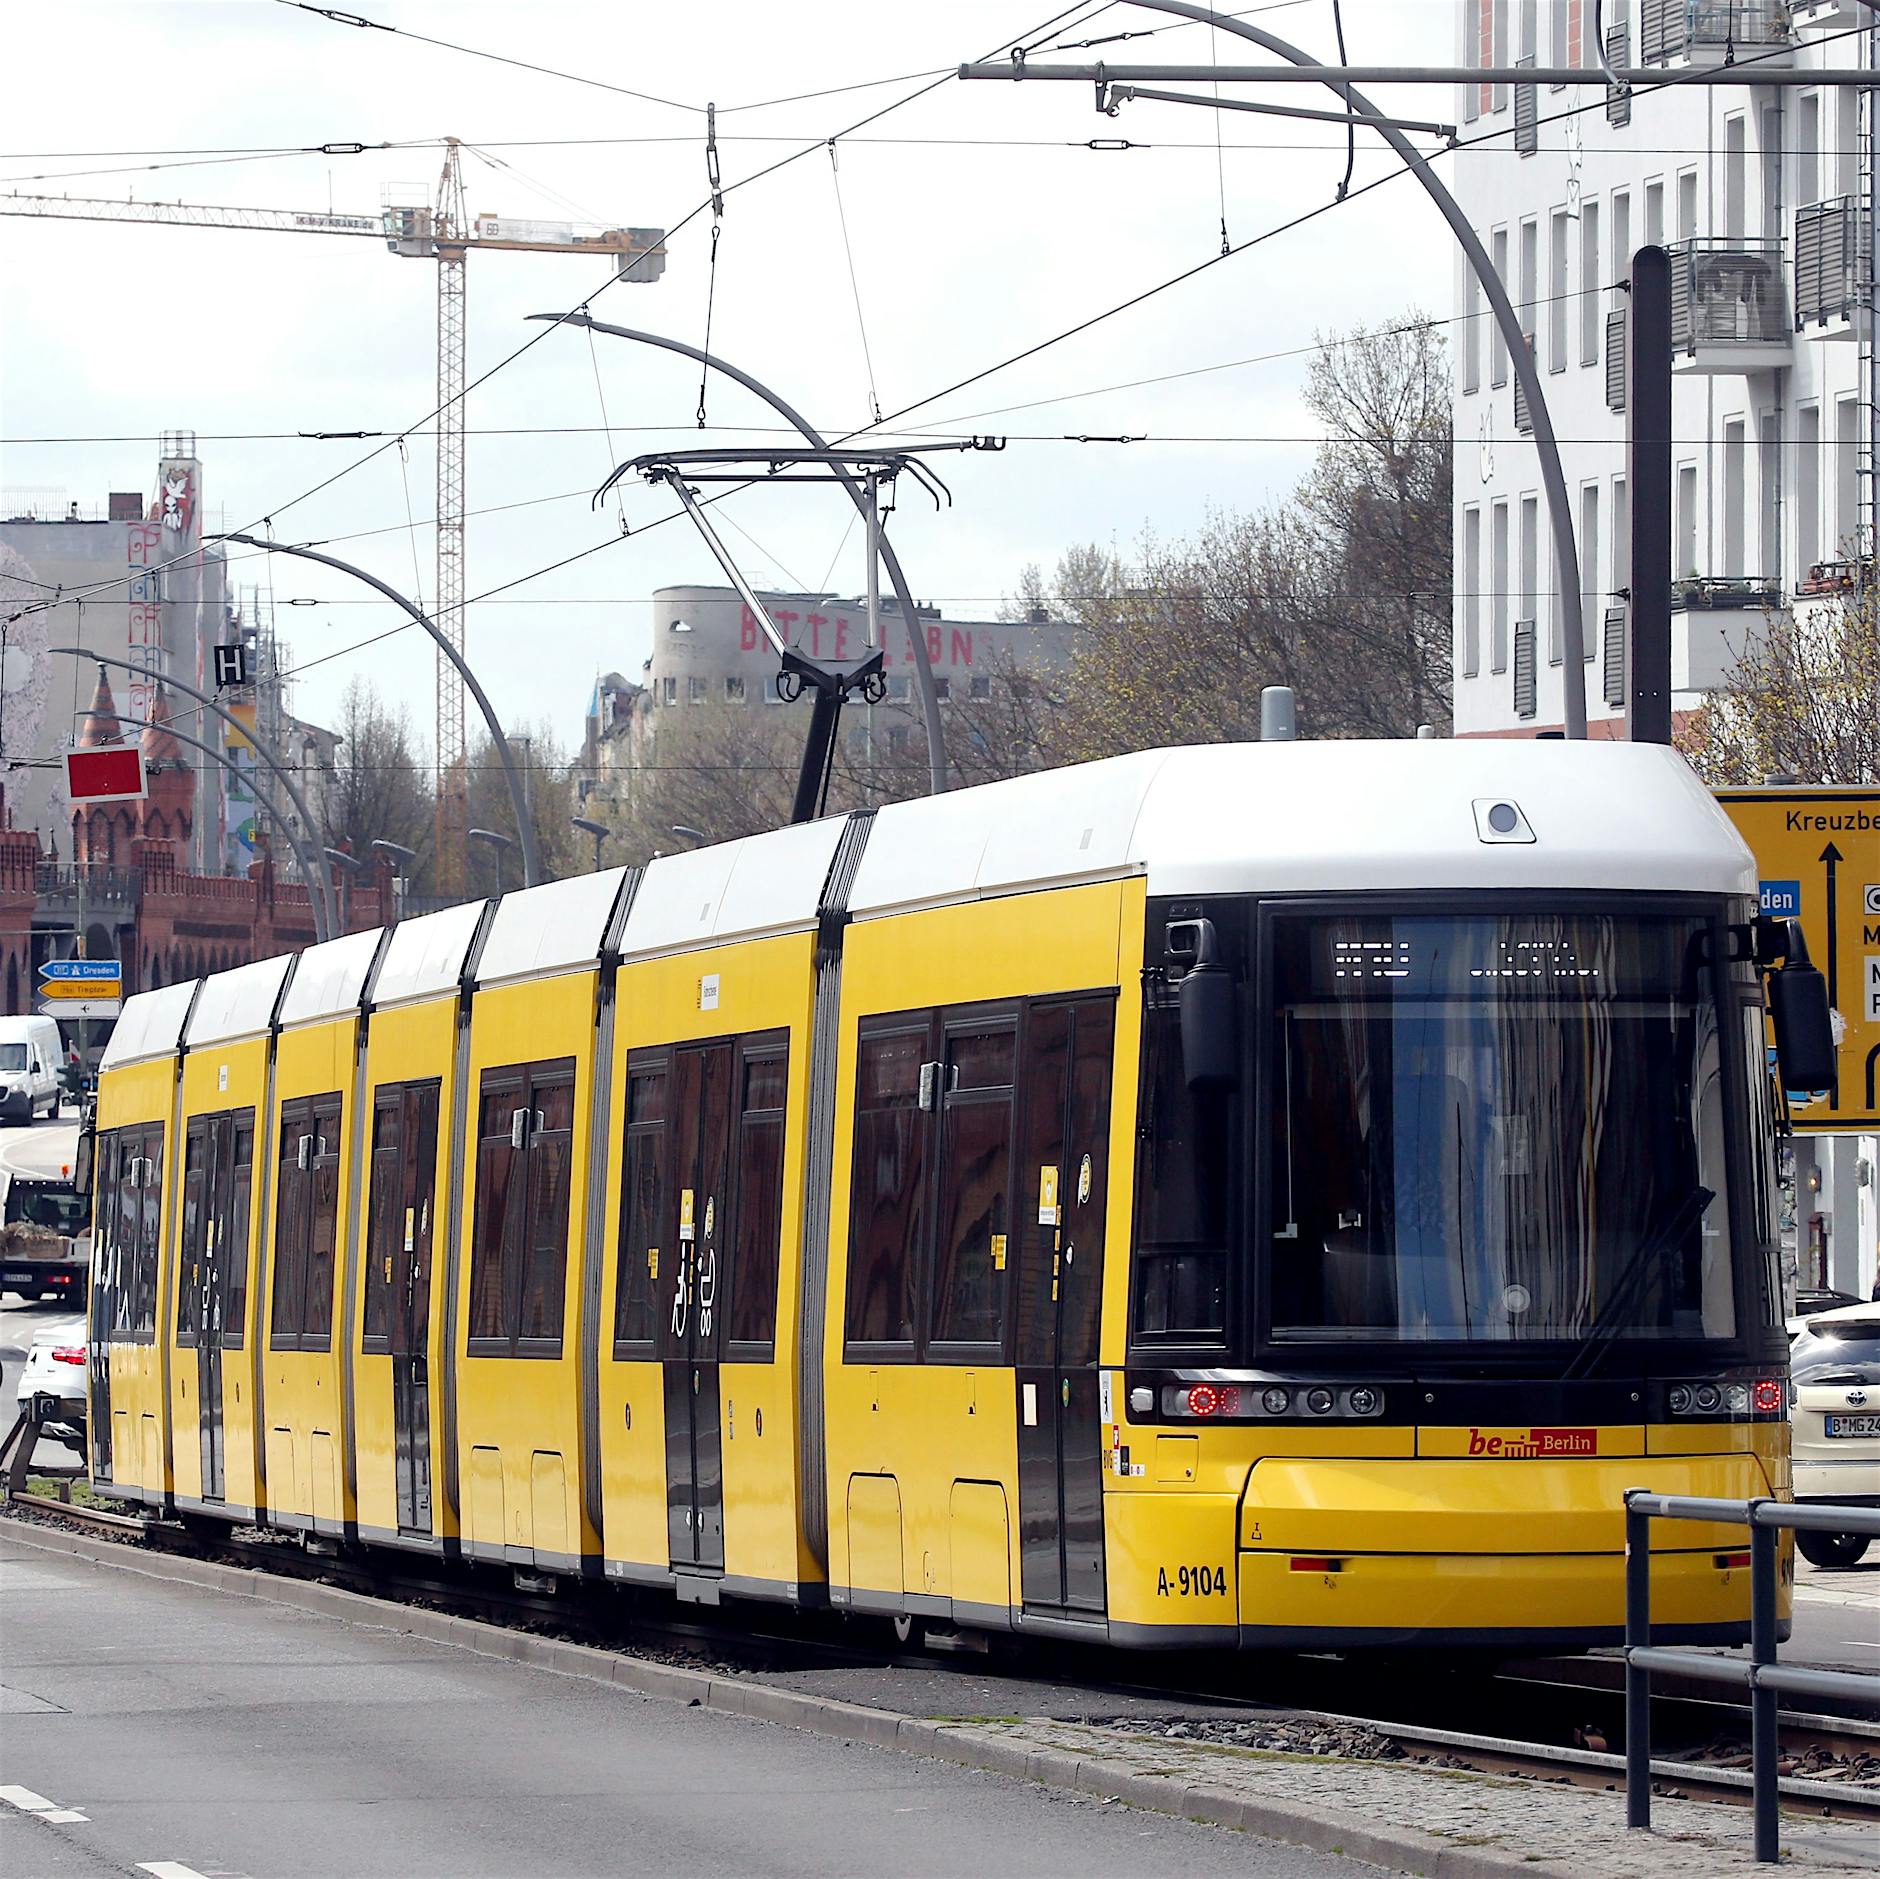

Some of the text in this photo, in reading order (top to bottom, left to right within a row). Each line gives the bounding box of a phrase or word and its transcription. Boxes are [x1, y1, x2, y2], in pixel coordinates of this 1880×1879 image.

[219, 649, 241, 681] H
[1543, 1435, 1591, 1450] Berlin
[1157, 1565, 1227, 1597] A-9104
